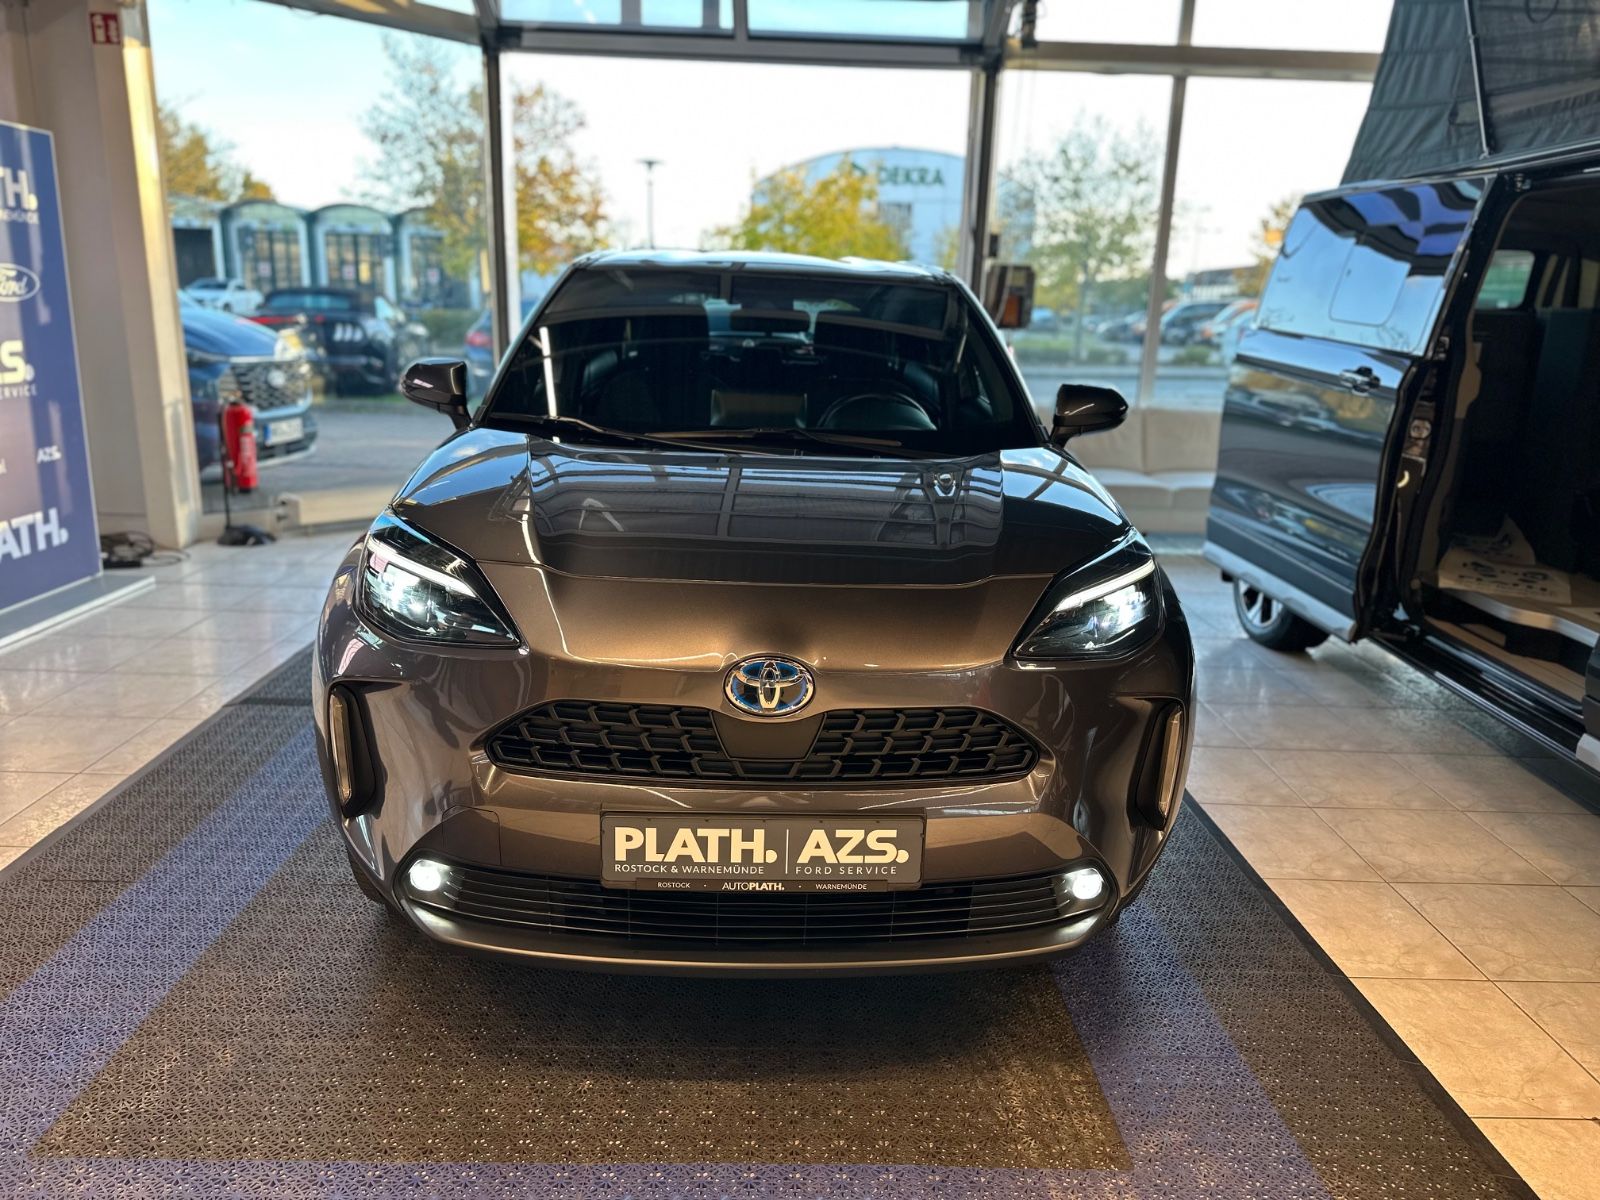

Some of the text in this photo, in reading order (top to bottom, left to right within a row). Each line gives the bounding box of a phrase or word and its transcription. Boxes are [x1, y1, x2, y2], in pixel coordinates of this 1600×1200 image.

[0, 339, 35, 384] S.
[615, 826, 777, 863] PLATH.
[797, 829, 909, 863] AZS.
[615, 864, 764, 874] ROSTOCK & WARNEMÜNDE
[795, 867, 897, 875] FORD SERVICE
